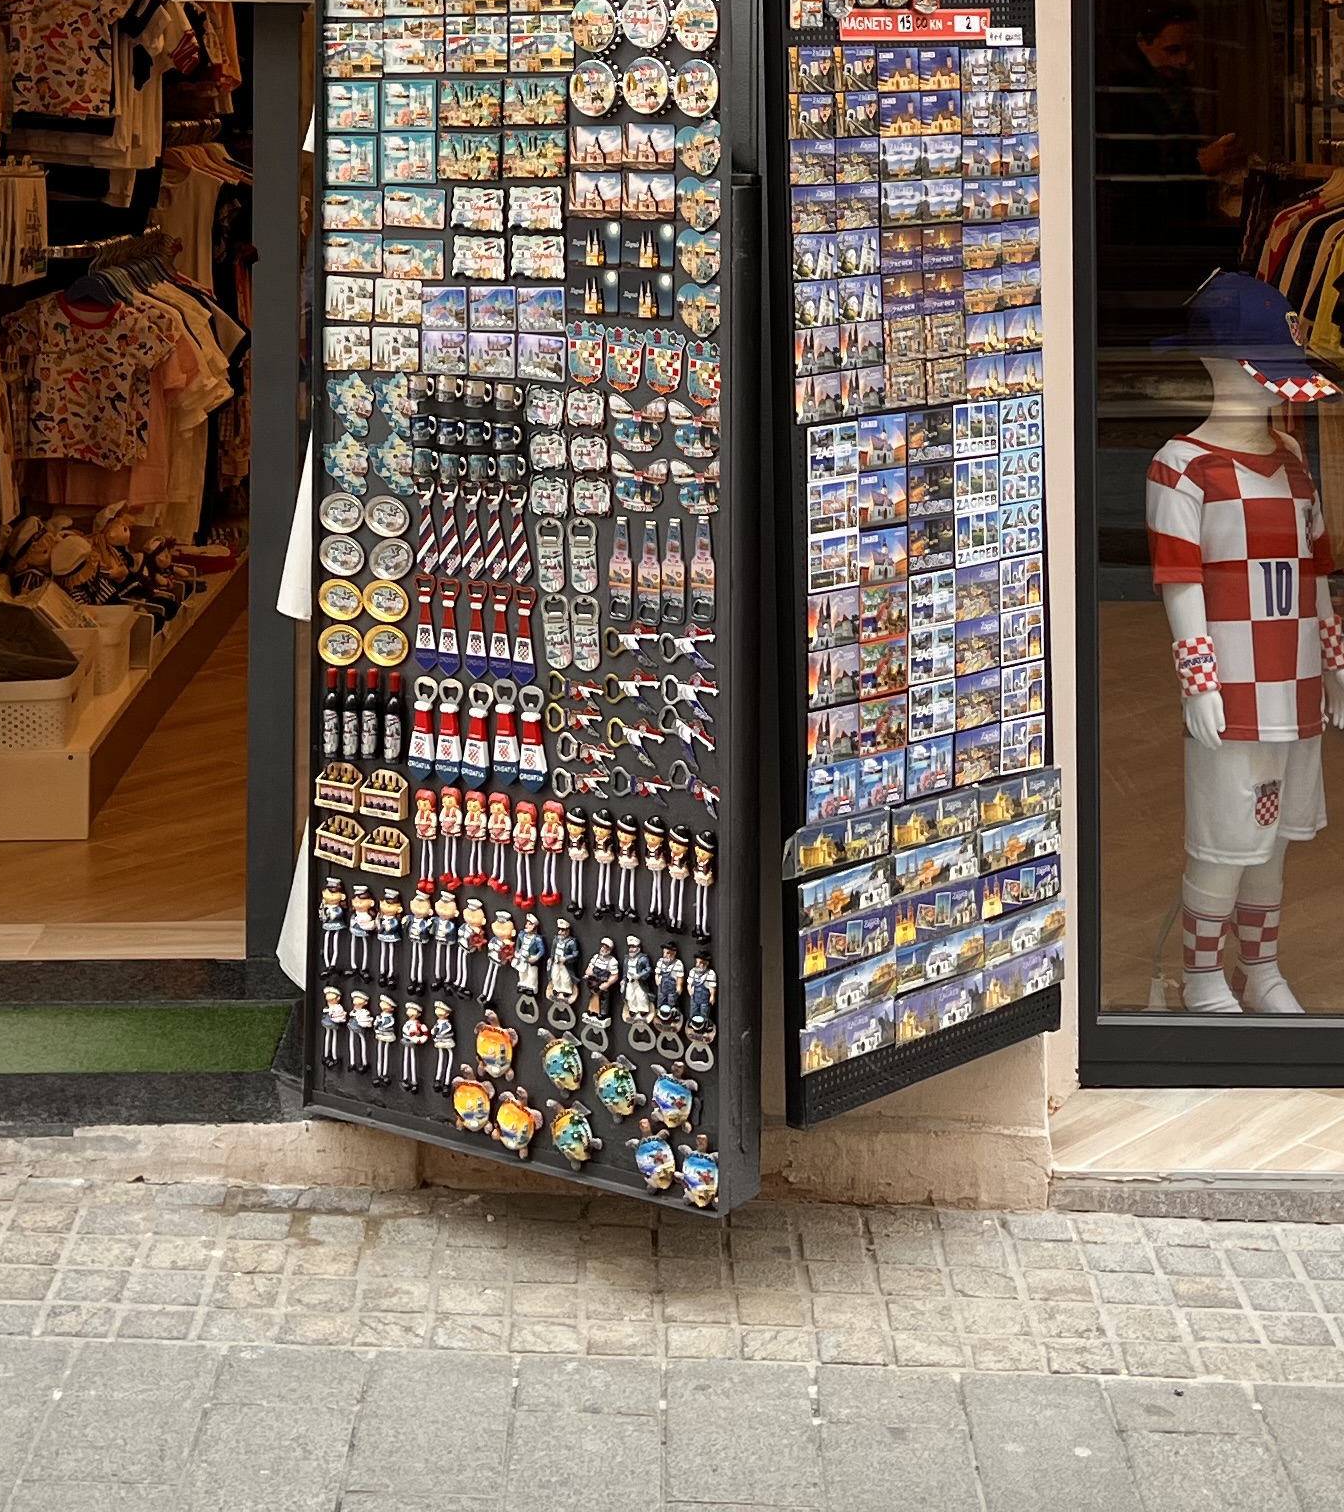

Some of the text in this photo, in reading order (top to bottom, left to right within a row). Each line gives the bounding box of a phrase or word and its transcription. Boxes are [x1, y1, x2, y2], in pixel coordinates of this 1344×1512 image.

[841, 15, 893, 31] MAGNETS
[929, 18, 943, 30] KN
[965, 15, 972, 29] 2
[956, 439, 997, 455] ZAGREB
[956, 494, 997, 511] ZAGREB
[957, 547, 998, 565] ZAGREB
[1258, 561, 1293, 617] 10
[408, 760, 430, 770] CROATIA
[461, 768, 485, 778] CROATIA
[493, 764, 516, 774] CROATIA
